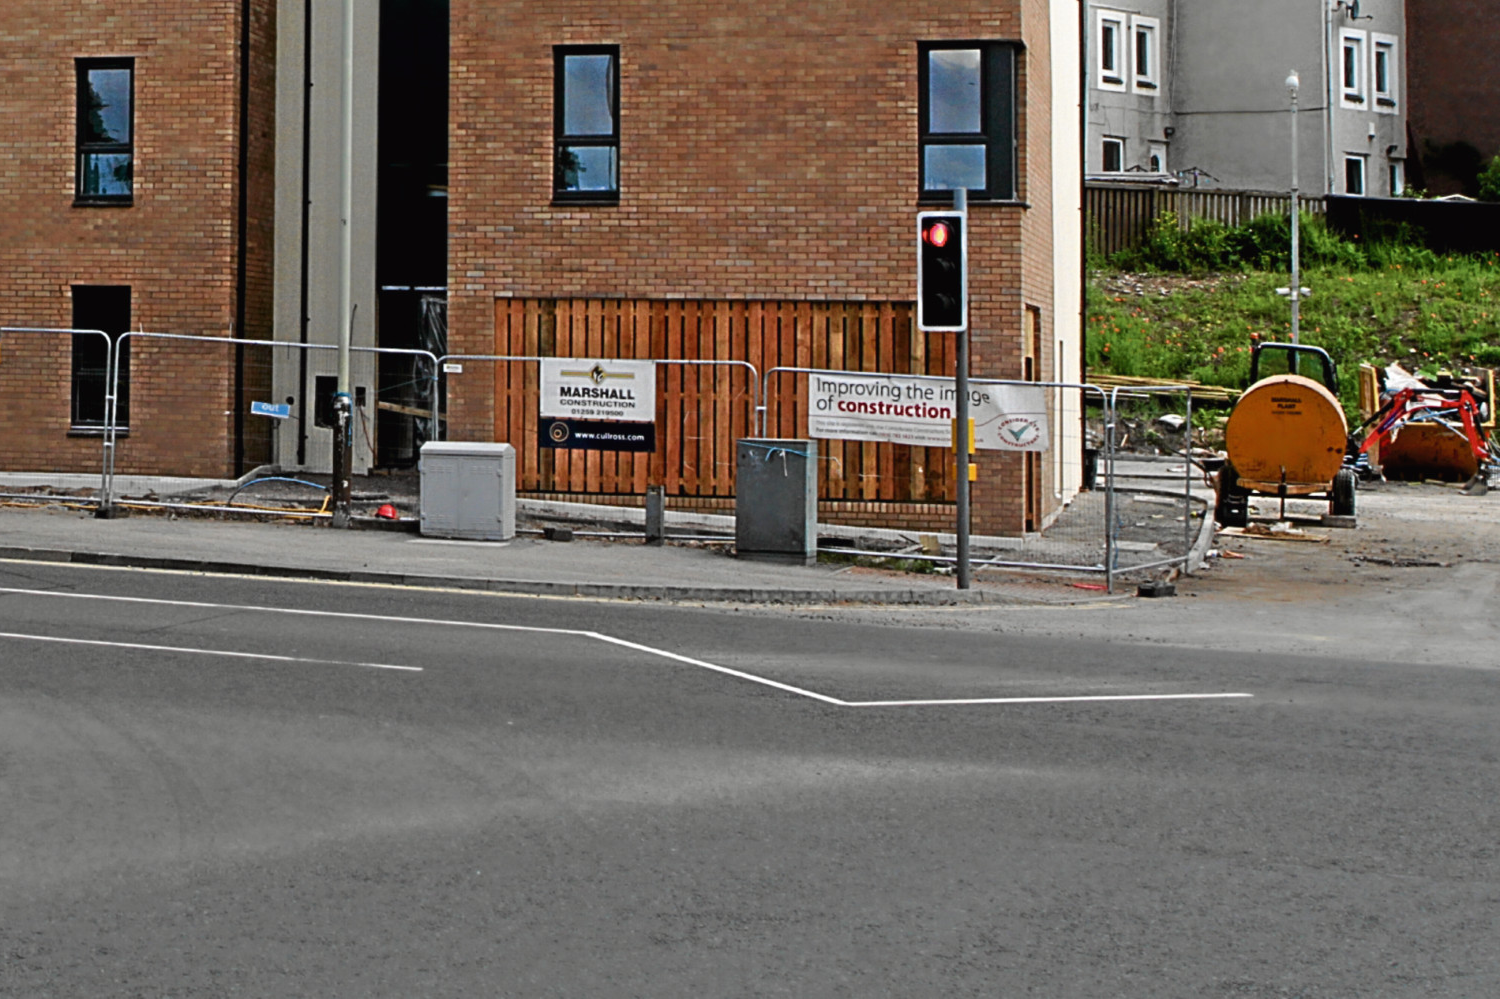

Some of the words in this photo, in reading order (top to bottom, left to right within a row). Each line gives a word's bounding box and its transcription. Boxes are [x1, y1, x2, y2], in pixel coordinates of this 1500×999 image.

[560, 386, 635, 400] MARSHALL
[816, 377, 901, 402] Improving
[906, 383, 934, 400] the
[940, 385, 990, 407] imge
[560, 399, 636, 408] CONSTRUCTION
[816, 395, 834, 411] of
[838, 400, 951, 419] construction
[575, 432, 645, 441] www.cullross.com
